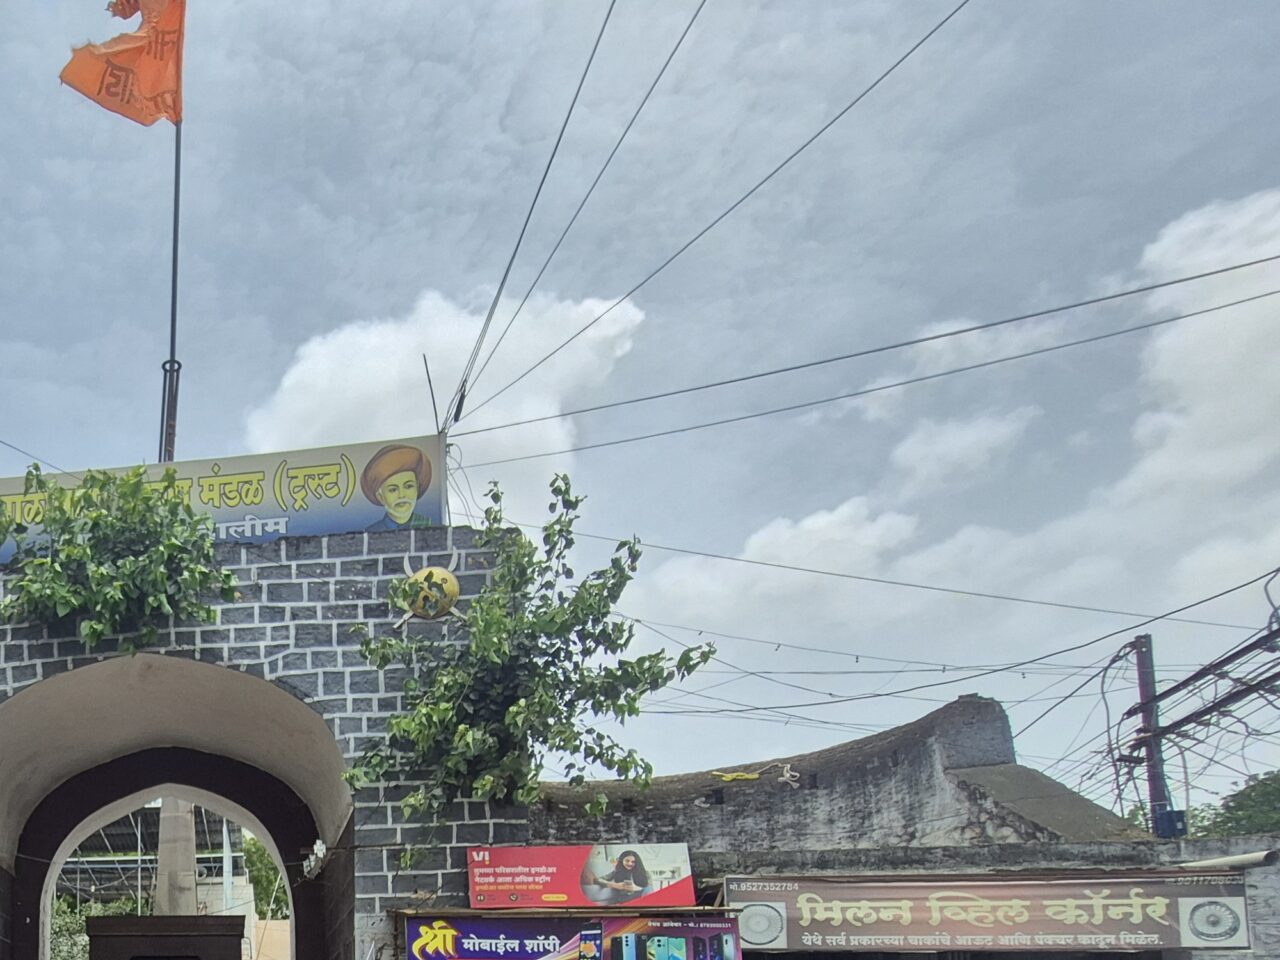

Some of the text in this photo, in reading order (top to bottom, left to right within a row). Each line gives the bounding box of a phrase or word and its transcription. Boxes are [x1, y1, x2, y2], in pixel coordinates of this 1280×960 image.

[198, 462, 265, 508] मंडळ
[273, 453, 356, 512] (ट्रस्ट)
[796, 888, 1169, 927] मिलन व्हिल कॉर्नर
[462, 934, 520, 955] मोबाईल
[523, 935, 561, 954] शॉपी
[826, 931, 846, 946] सर्व
